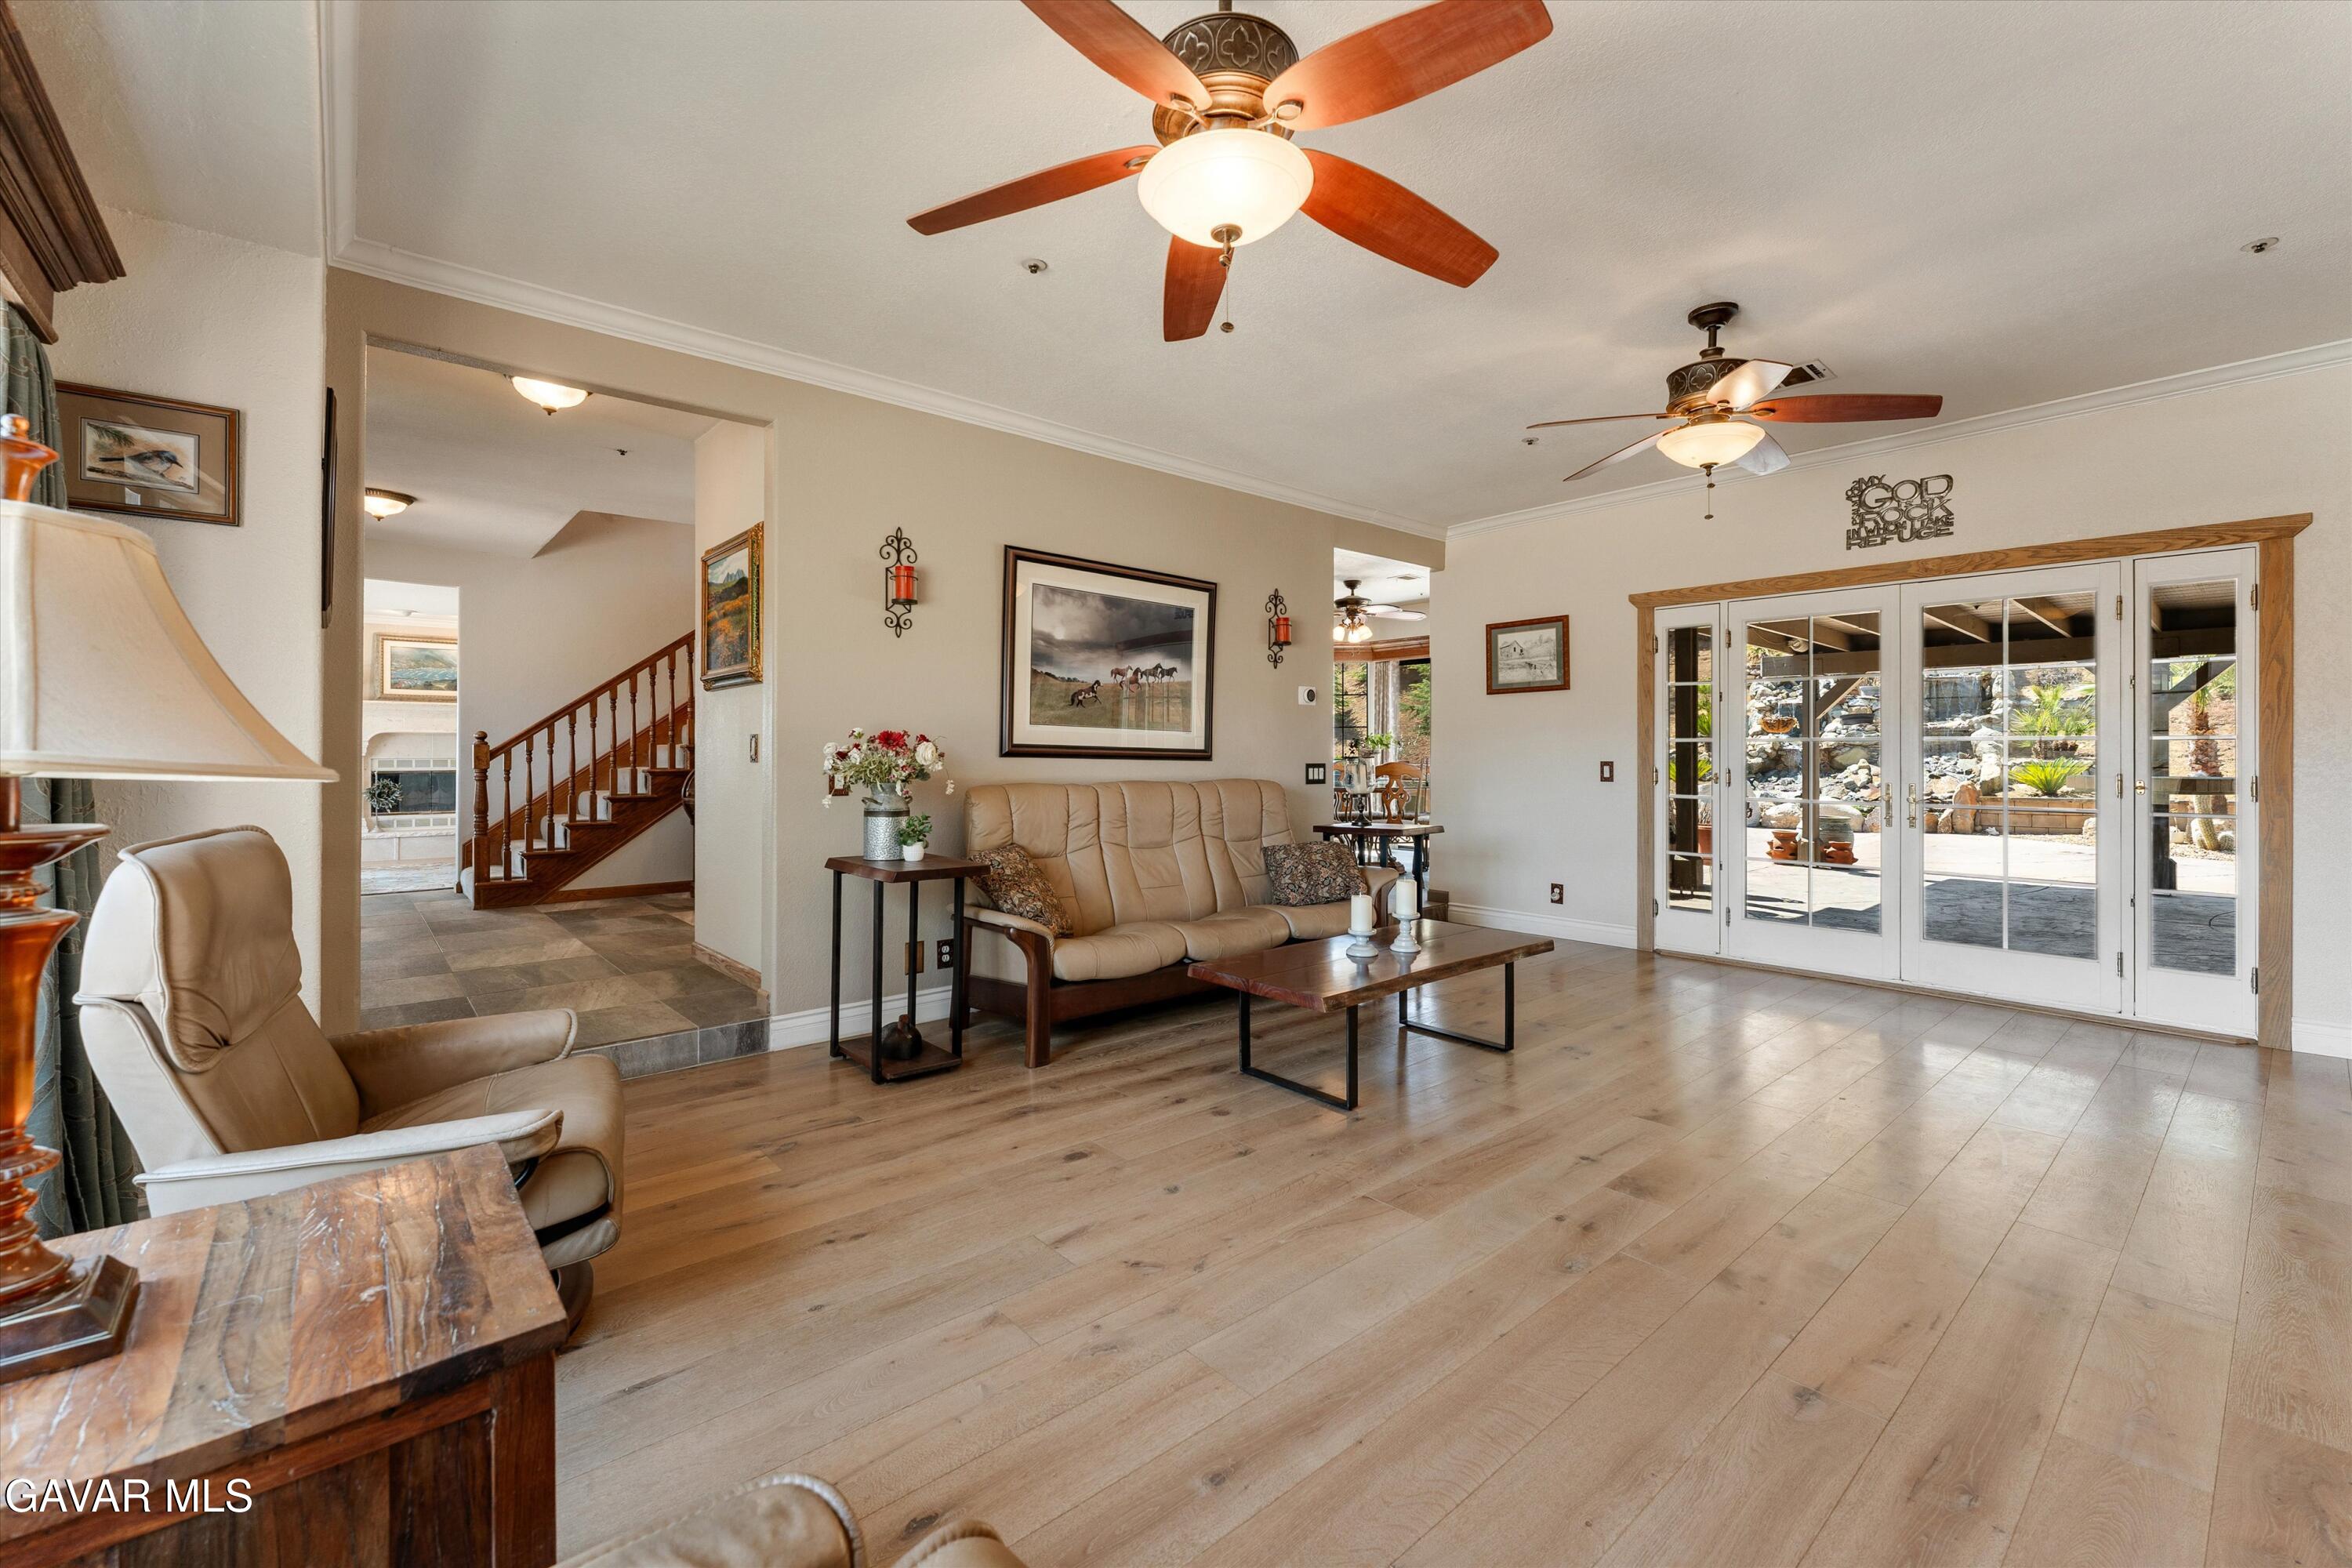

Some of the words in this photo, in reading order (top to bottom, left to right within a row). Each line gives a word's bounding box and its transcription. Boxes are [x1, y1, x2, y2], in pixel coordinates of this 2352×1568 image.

[1858, 474, 1886, 489] MY
[1859, 474, 1954, 511] GOD
[1859, 498, 1954, 528] ROCK
[1846, 528, 1860, 539] IN
[1846, 526, 1954, 550] REFUGE
